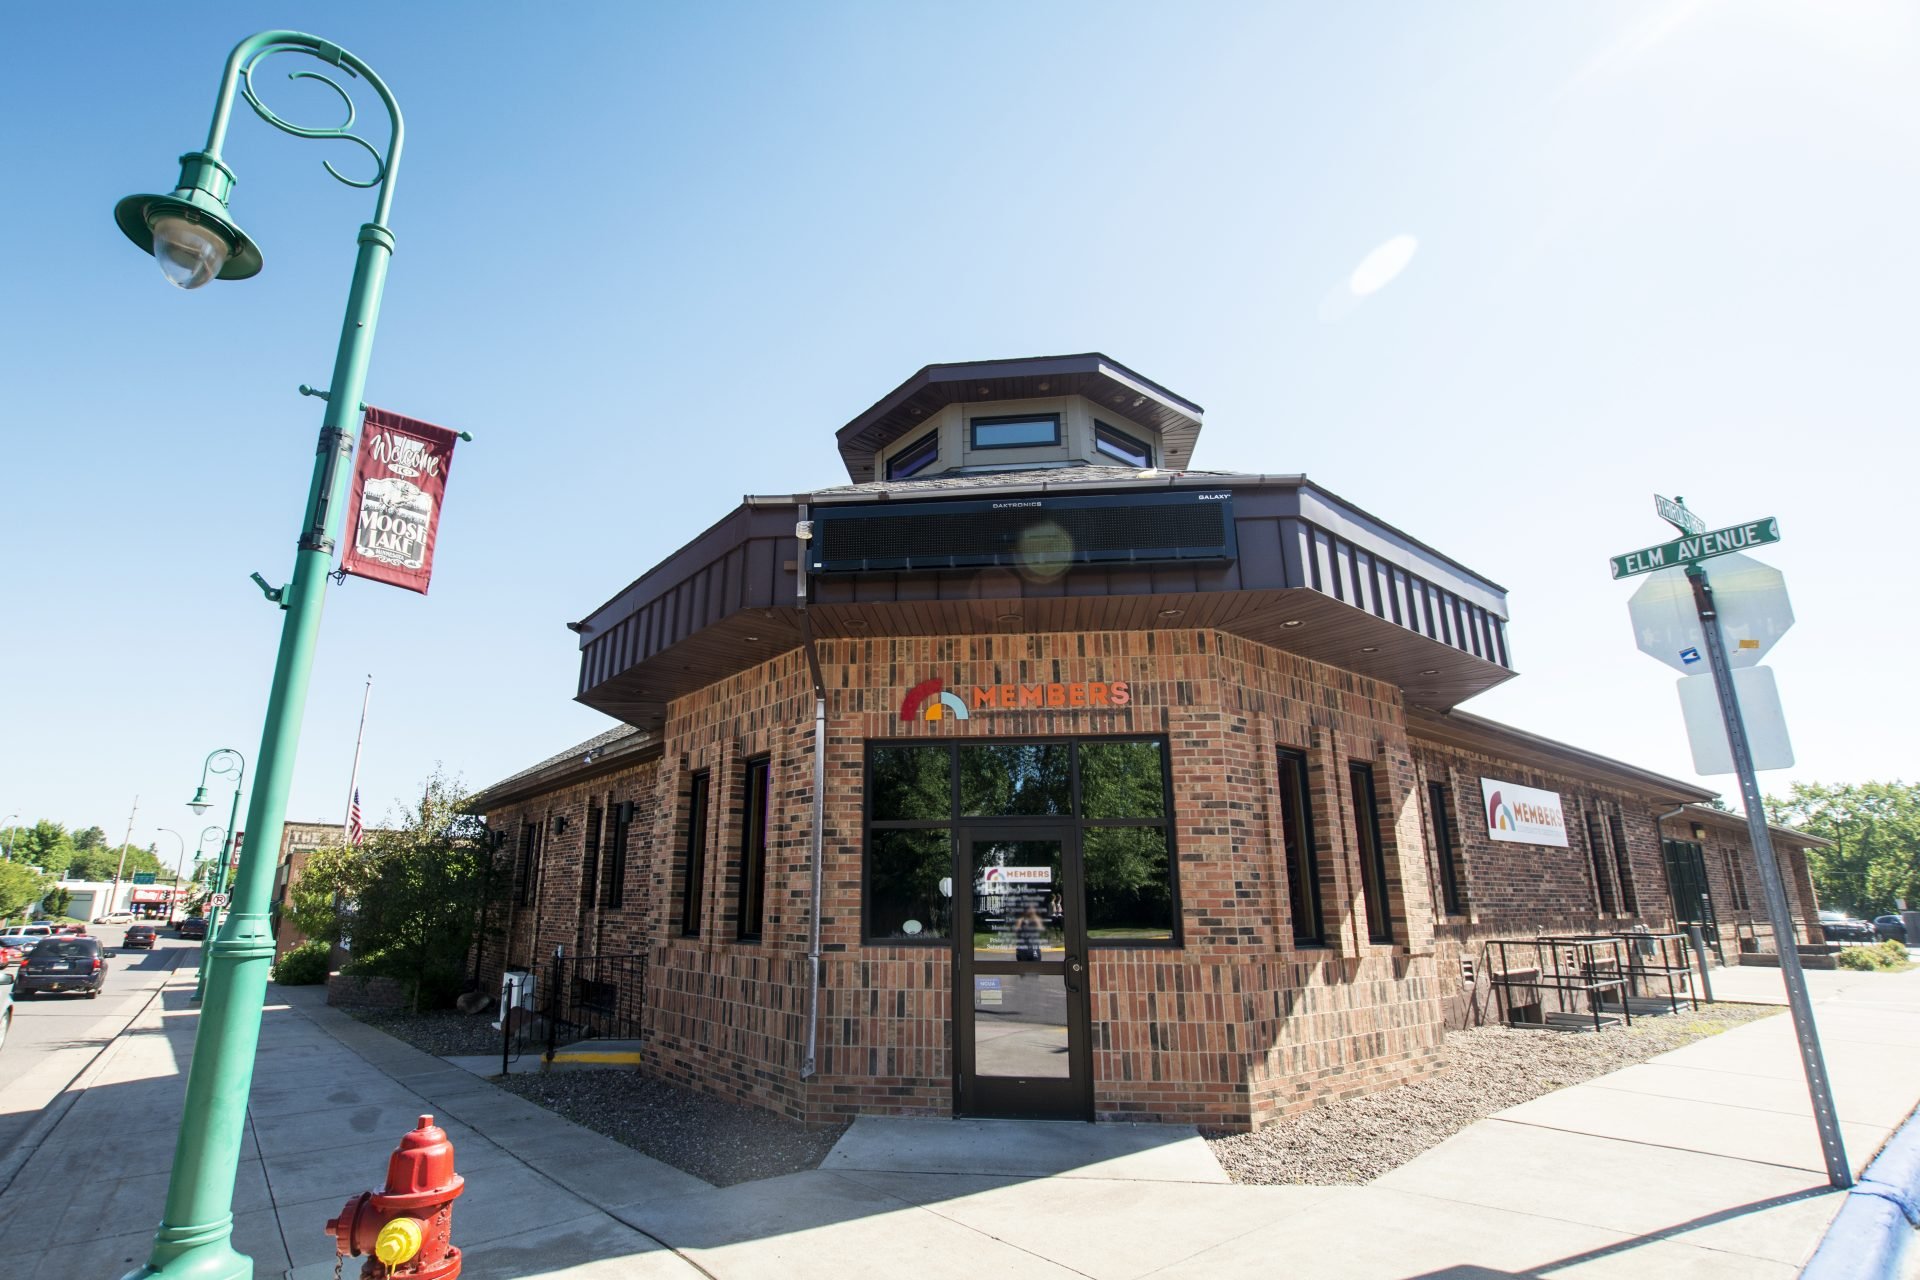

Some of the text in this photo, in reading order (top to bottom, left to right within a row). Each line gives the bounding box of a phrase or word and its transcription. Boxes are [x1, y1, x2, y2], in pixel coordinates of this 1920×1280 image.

[370, 432, 439, 477] Welcome
[993, 501, 1042, 509] DAKTRONICS
[1198, 493, 1231, 501] GALAXY
[359, 510, 427, 545] MOOSE
[367, 529, 415, 557] LAKE
[1625, 524, 1761, 574] ELM AVENUE
[973, 681, 1130, 709] MEMBERS
[1513, 801, 1563, 827] MEMBERS
[1006, 870, 1050, 878] MEMBERS
